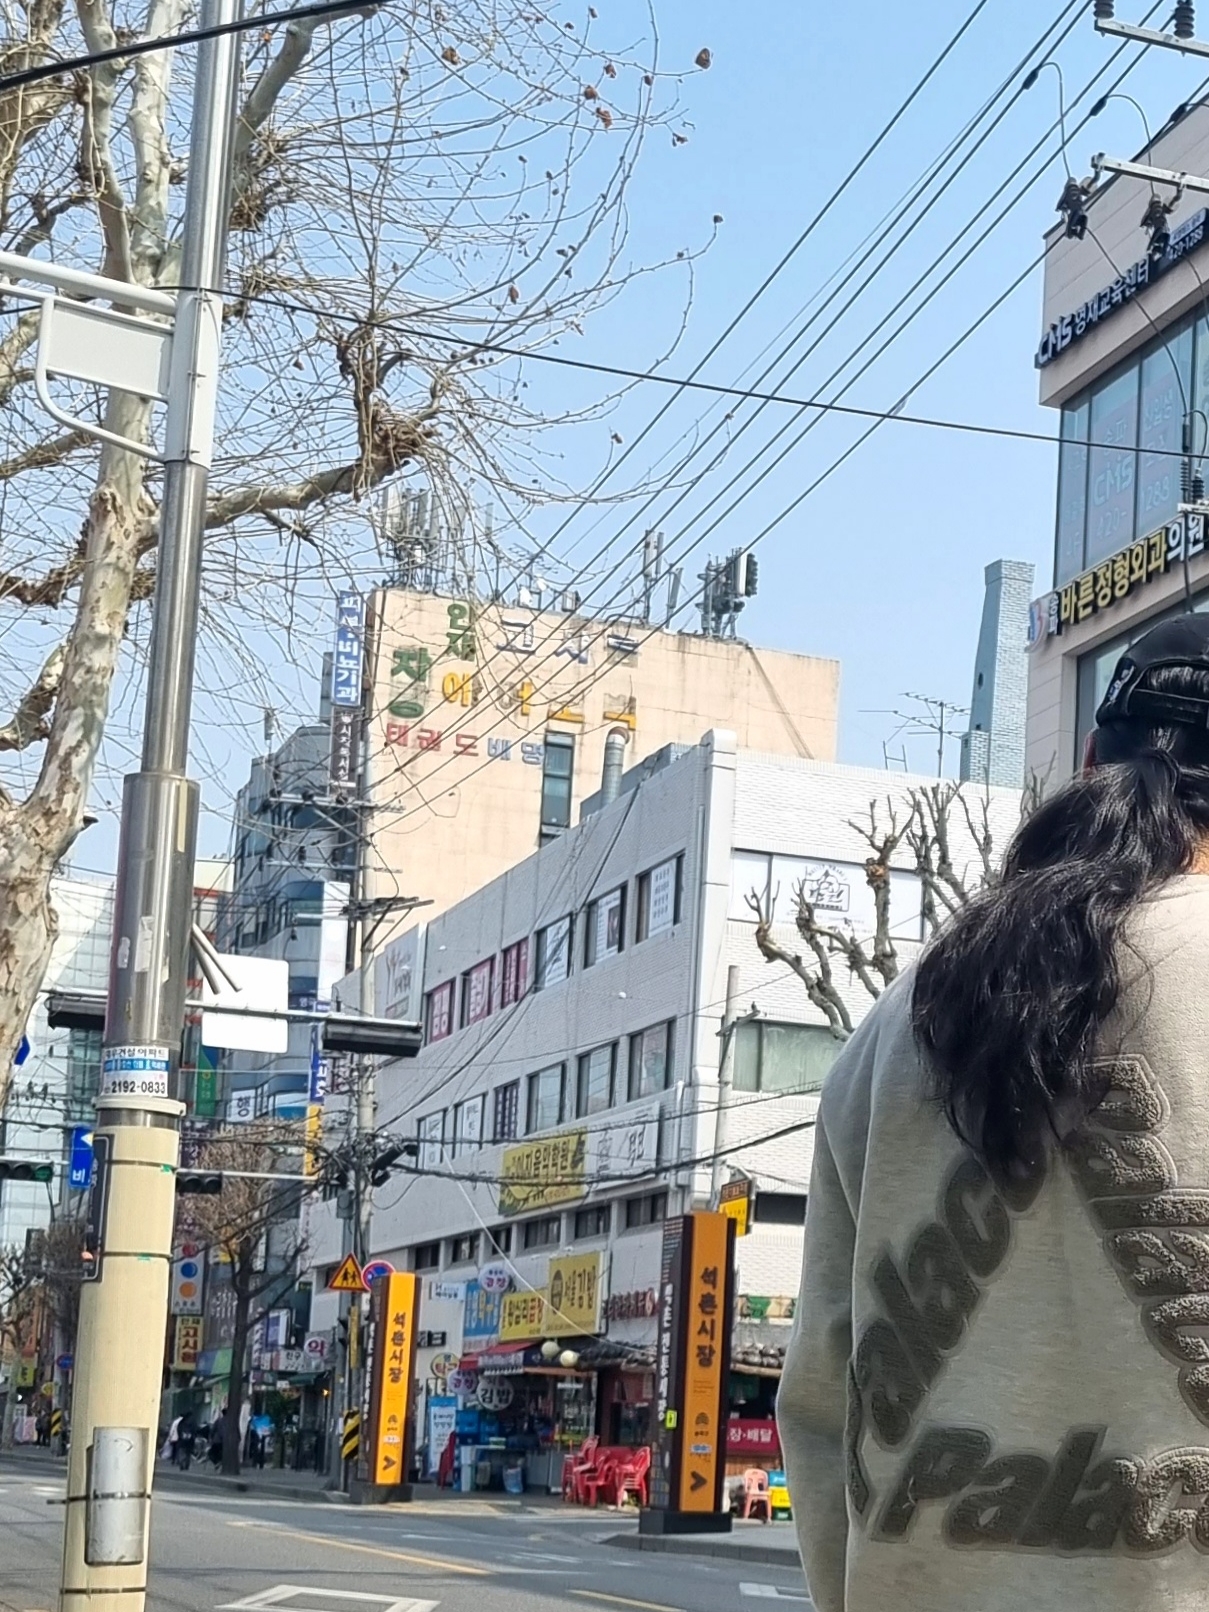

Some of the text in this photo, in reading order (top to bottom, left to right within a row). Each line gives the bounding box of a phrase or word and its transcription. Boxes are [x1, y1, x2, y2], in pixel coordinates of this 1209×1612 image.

[1038, 258, 1149, 364] CMS 영재교육센터
[1093, 454, 1133, 506] CMS
[1061, 511, 1204, 624] 바른정형외과의원
[112, 1080, 166, 1094] 2192-0833
[696, 1266, 719, 1370] 석촌시장
[728, 1428, 773, 1443] 장·배달
